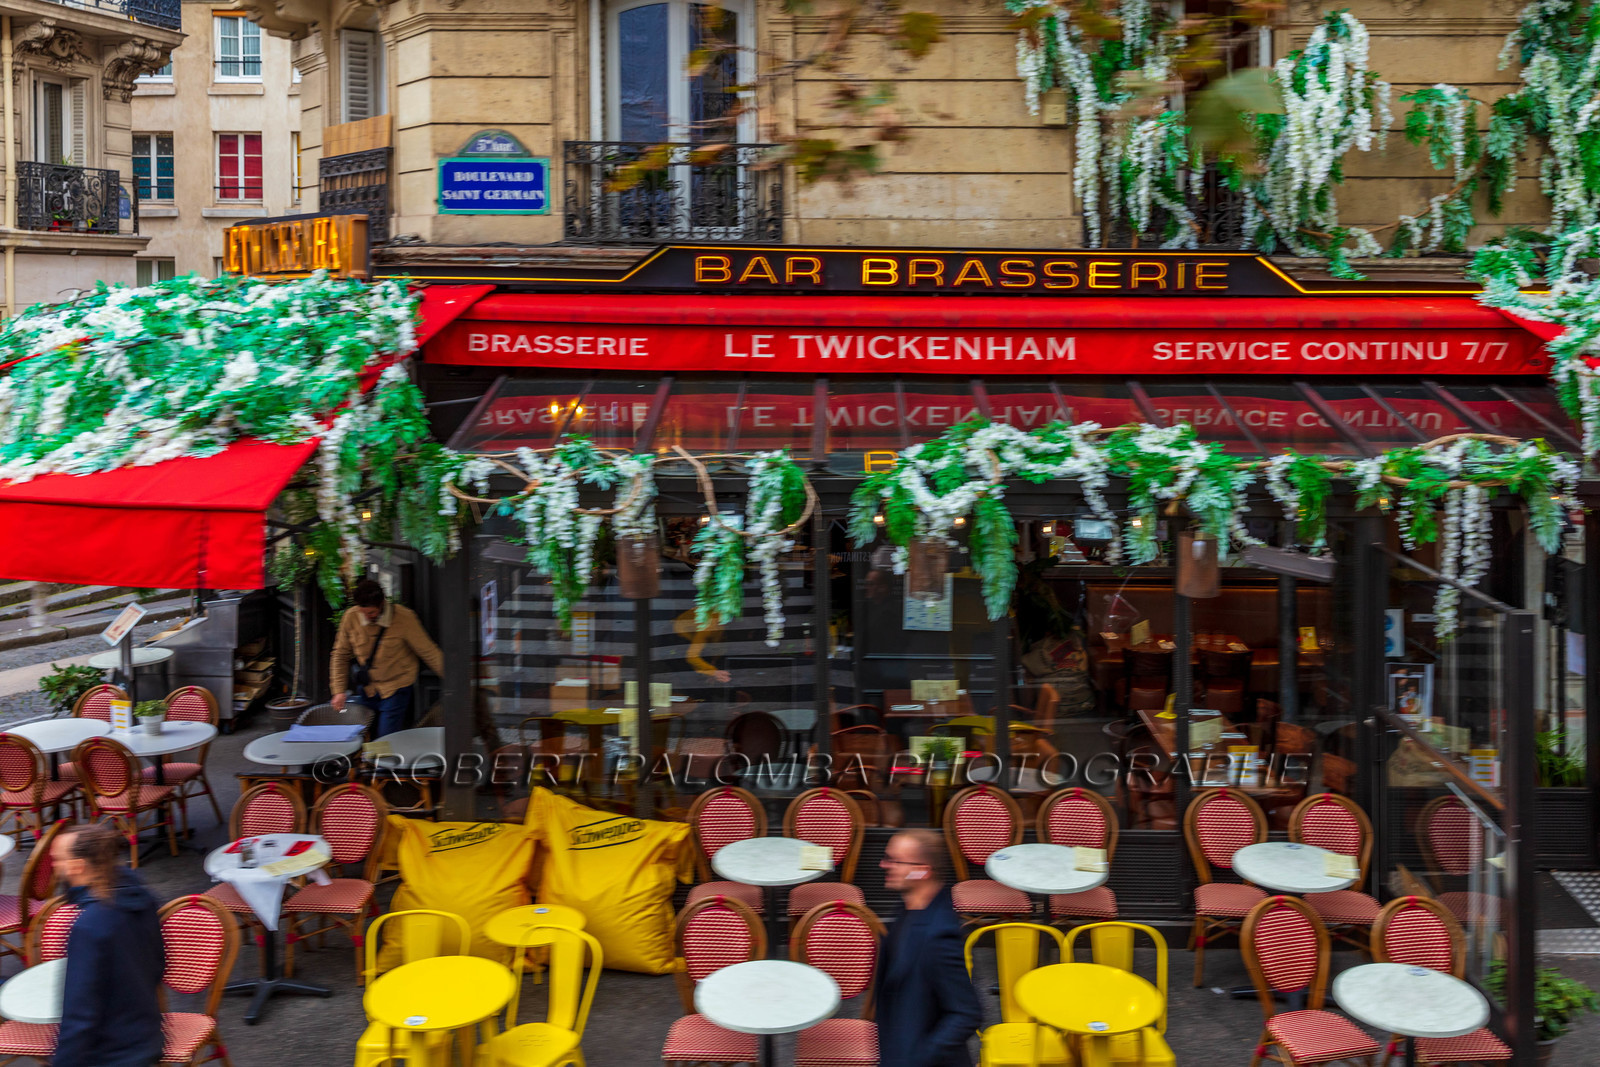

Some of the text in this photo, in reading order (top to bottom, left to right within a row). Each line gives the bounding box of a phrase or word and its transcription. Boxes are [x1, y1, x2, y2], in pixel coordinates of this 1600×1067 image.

[453, 171, 535, 182] BOULEVARD
[441, 190, 545, 200] SAINT GERMAIN
[694, 255, 1230, 290] BAR BRASSERIE
[467, 333, 1510, 363] BRASSERIE LE TWICKENHAM SERVICE CONTINU 7/7
